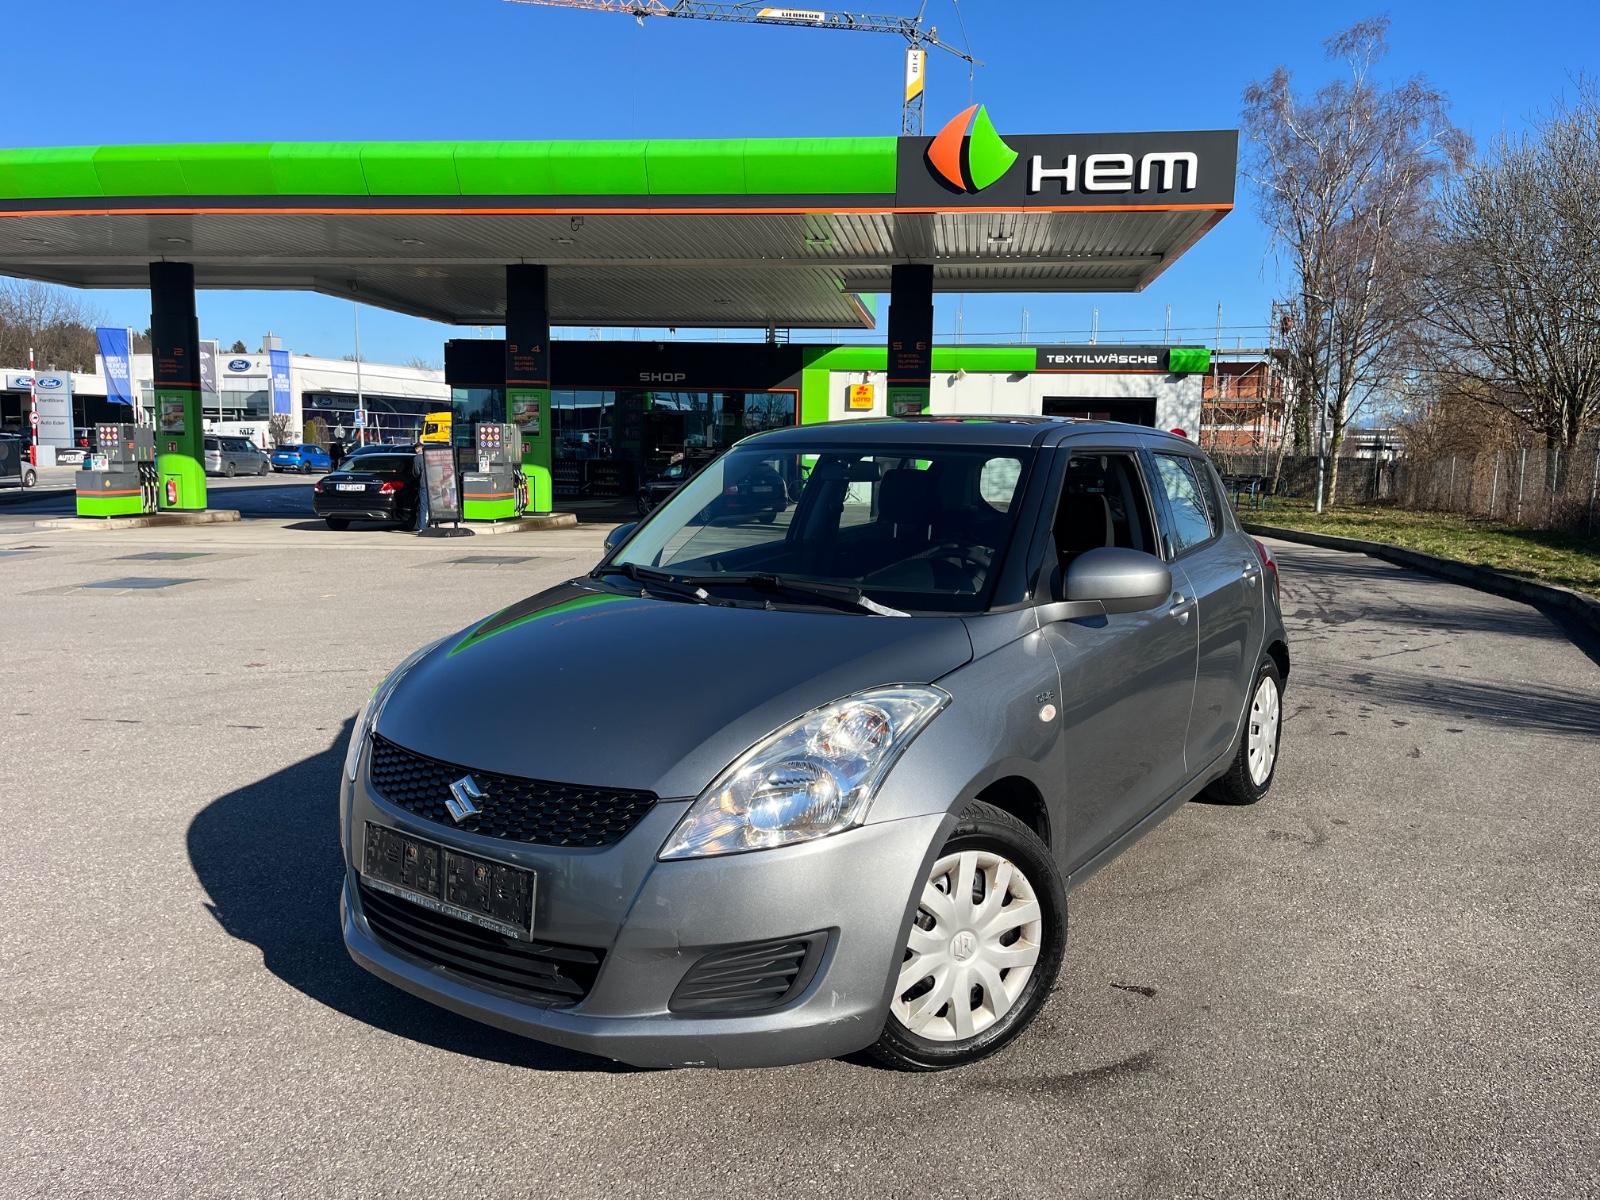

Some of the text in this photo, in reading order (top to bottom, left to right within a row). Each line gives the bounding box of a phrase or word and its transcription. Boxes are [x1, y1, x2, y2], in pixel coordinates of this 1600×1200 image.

[509, 344, 542, 353] 3 4
[916, 341, 927, 351] 6
[639, 372, 686, 382] SHOP
